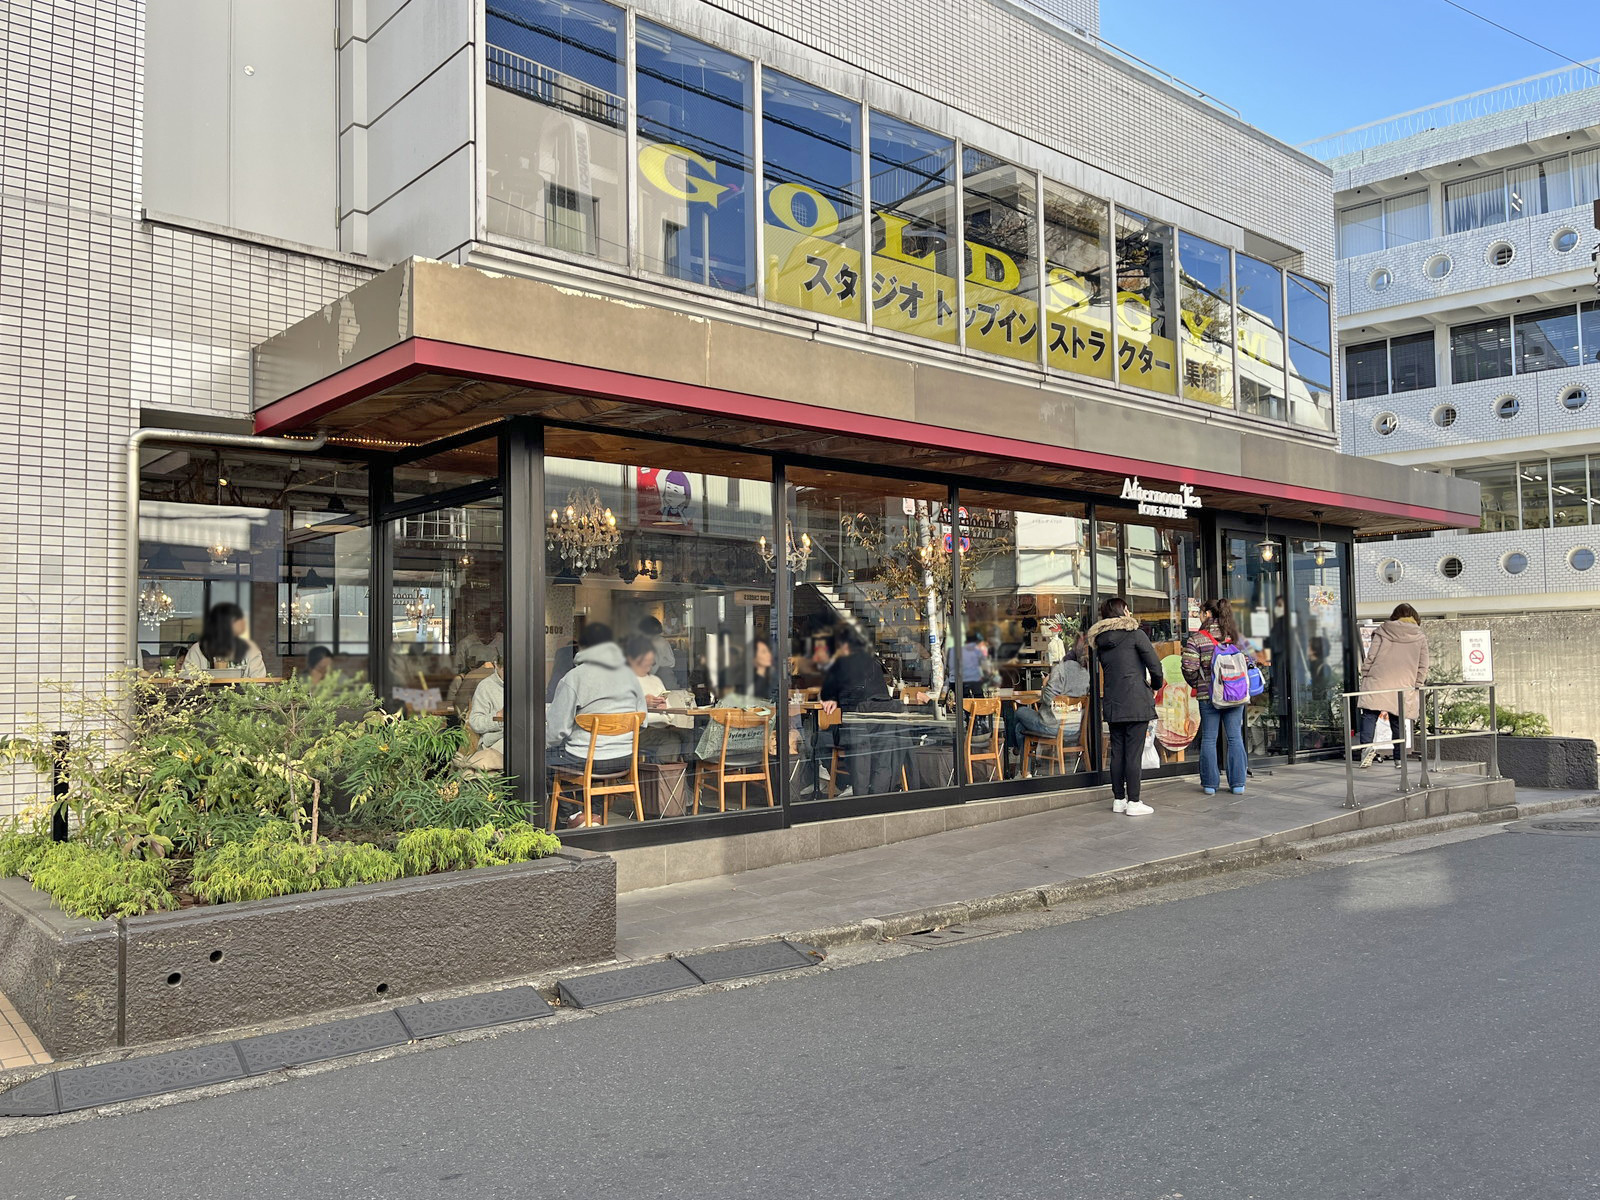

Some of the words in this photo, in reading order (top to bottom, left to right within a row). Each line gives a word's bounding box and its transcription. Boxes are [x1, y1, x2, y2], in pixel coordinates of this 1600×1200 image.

[638, 143, 1090, 314] GOLDS
[1120, 476, 1183, 507] Afternoon
[1180, 484, 1203, 508] Tea
